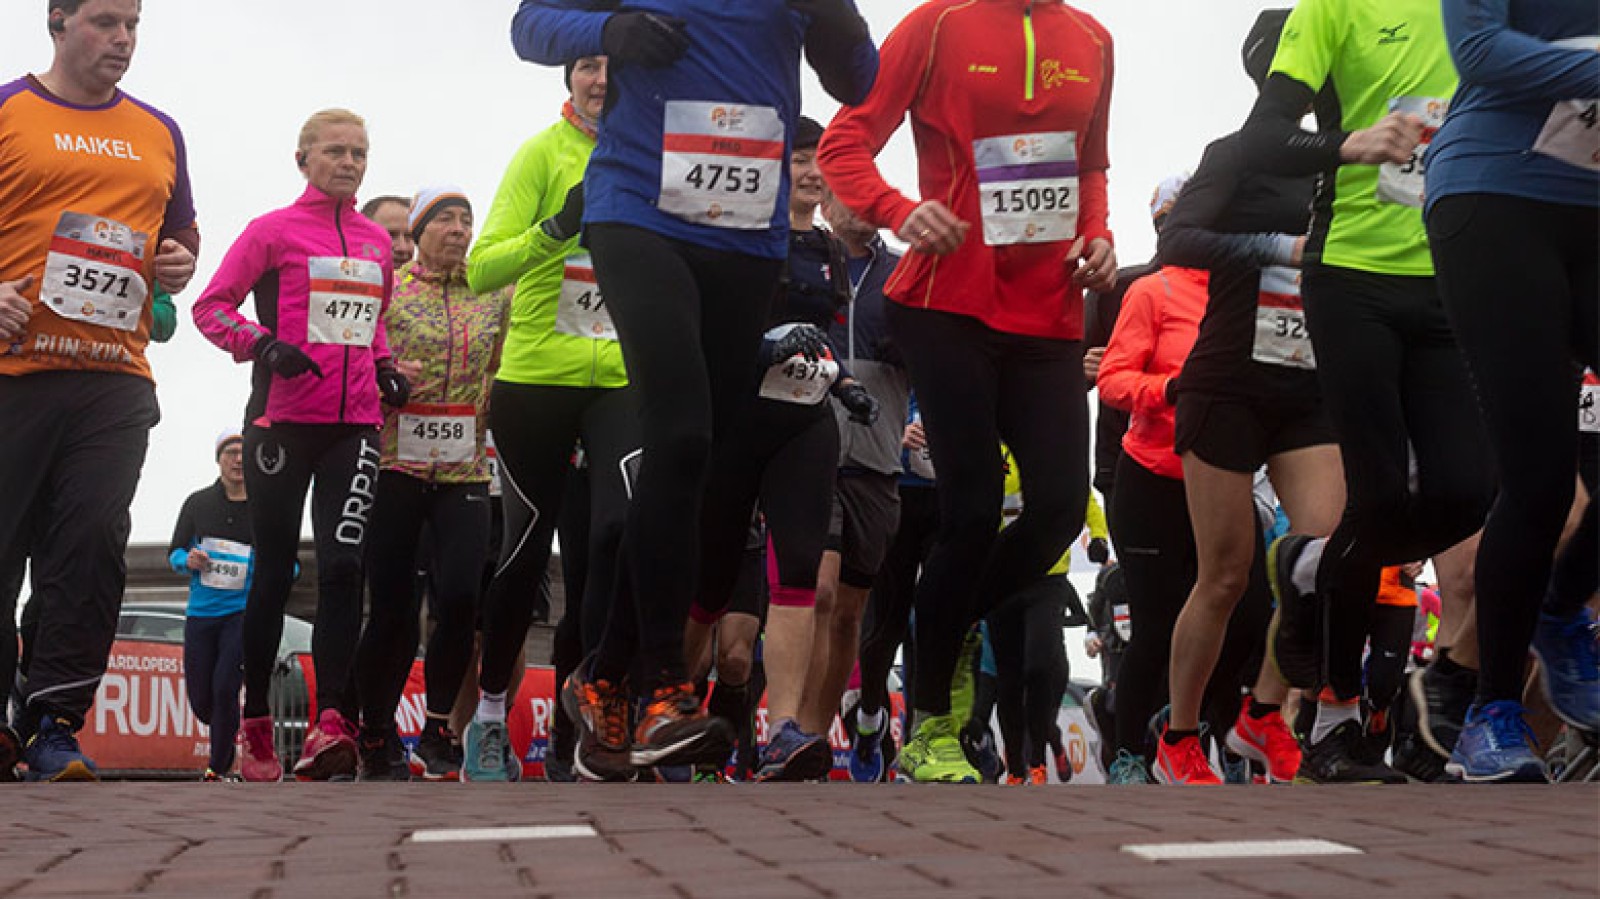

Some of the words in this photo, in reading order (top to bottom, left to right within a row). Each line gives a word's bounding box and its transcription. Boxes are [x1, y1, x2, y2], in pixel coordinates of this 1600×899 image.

[54, 134, 142, 160] MAIKEL
[685, 163, 760, 194] 4753
[992, 187, 1070, 213] 15092
[64, 265, 131, 299] 3571
[325, 300, 373, 322] 4775
[1275, 316, 1305, 338] 32
[412, 422, 464, 440] 4558
